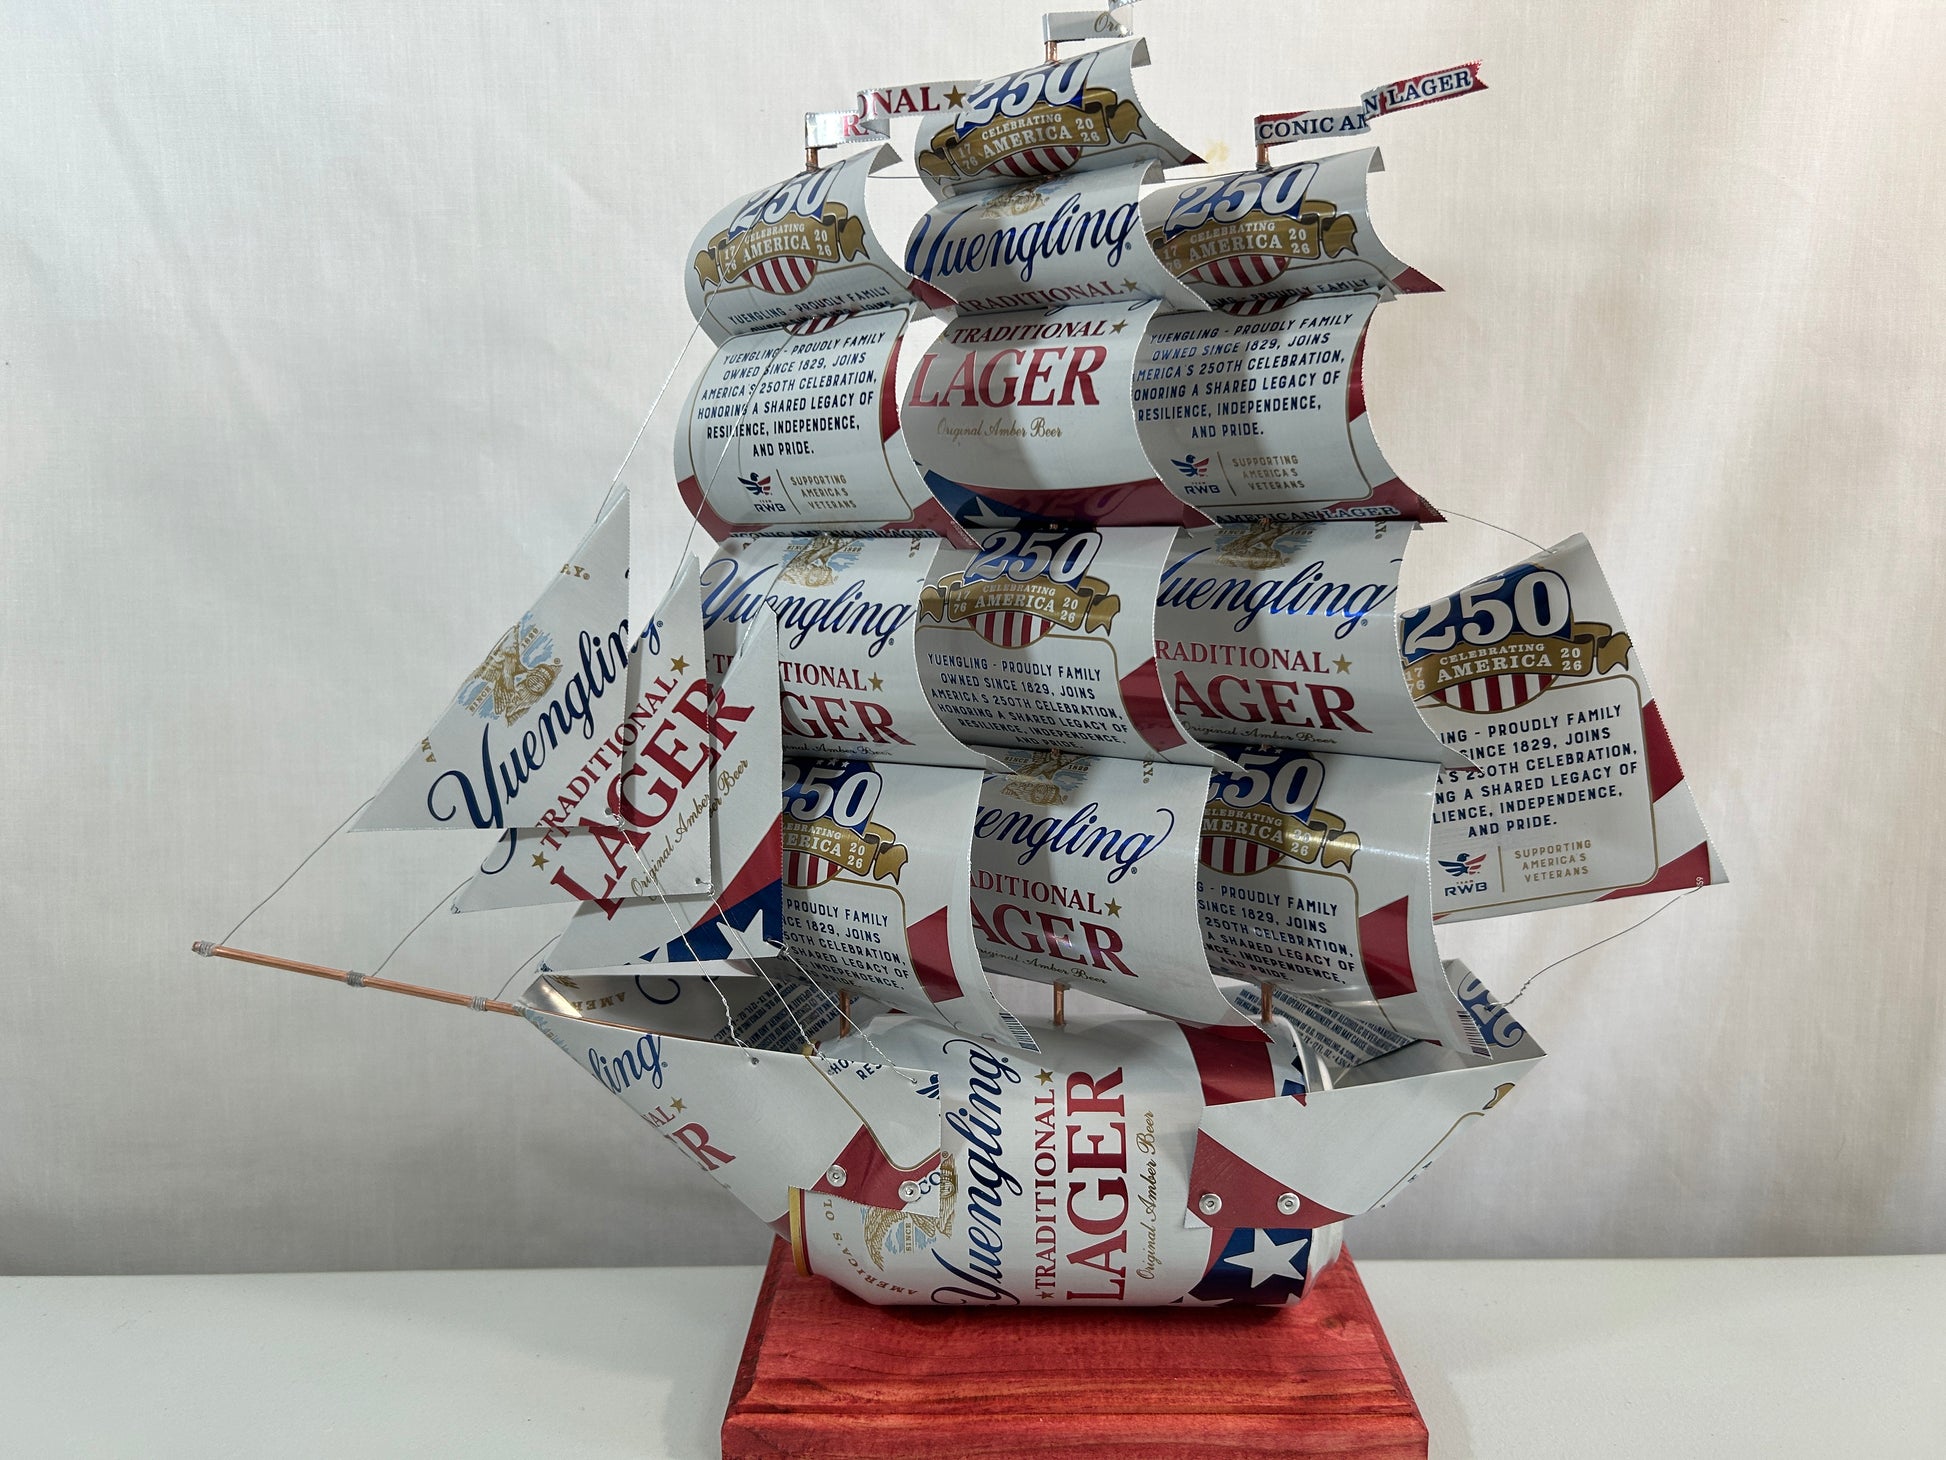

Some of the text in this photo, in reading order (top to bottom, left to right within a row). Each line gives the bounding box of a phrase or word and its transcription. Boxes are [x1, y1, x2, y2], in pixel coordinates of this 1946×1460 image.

[955, 53, 1099, 136] 250
[1387, 70, 1473, 107] LAGER
[981, 113, 1062, 141] CELEBRATING
[1256, 117, 1334, 139] CONIC
[982, 126, 1073, 160] AMERICA
[729, 161, 845, 236] 250
[1164, 163, 1319, 235] 250
[744, 223, 805, 244] CELEBRATING
[904, 192, 1139, 282] Yuengling
[1188, 234, 1283, 262] AMERICA
[1190, 222, 1276, 245] CELEBRATING
[742, 236, 811, 262] AMERICA
[956, 280, 1123, 312] TRADITIONAL
[951, 320, 1107, 344] TRADITIONAL
[1150, 314, 1353, 345] YUENGLING PROUDLY FAMILY
[723, 332, 887, 365] YUENGLING PROUDLY FAMILY
[1152, 332, 1330, 361] OWNED SINCE 1829, JOINS
[723, 352, 867, 381] OWNED SINCE 1829, JOINS
[908, 346, 1108, 408] LAGER
[1199, 350, 1345, 376] 250TH CELEBRATION,
[759, 370, 878, 395] 250TH CELEBRATION,
[1205, 370, 1341, 395] SHARED LEGACY OF
[697, 391, 874, 420] HONORING SHARED LEGACY OF
[1138, 395, 1321, 421] RESILIENCE, INDEPENDENCE,
[707, 414, 861, 440] RESILIENCE, INDEPENDENCE,
[984, 419, 1028, 437] Amber
[1030, 417, 1063, 437] Beer
[1192, 422, 1264, 439] AND PRIDE.
[753, 440, 815, 457] AND PRIDE.
[1232, 455, 1299, 467] SUPPORTING
[790, 474, 847, 486] SUPPORTING
[1248, 480, 1305, 491] VETERANS
[808, 500, 857, 510] VETERANS
[1323, 506, 1399, 518] LAGER
[965, 531, 1102, 585] 250
[974, 595, 1056, 613] AMERICA
[983, 585, 1056, 597] CELEBRATING
[1403, 569, 1571, 656] 250
[927, 653, 1101, 682] YUENGLING PROUDLY FAMILY
[1155, 640, 1330, 674] RADITIONAL
[1437, 654, 1552, 682] AMERICA
[1440, 643, 1545, 666] CELEBRATING
[1560, 648, 1580, 659] 20
[1562, 661, 1582, 671] 26
[941, 673, 1096, 700] OWNED SINCE 1829, JOINS
[994, 694, 1123, 720] 250TH CELEBRATION,
[1174, 670, 1373, 734] AGER
[937, 703, 1129, 734] HONORING SHARED LEGACY OF
[957, 718, 1126, 744] RESILIENCE, INDEPENDENCE,
[1488, 704, 1622, 738] PROUDLY FAMILY
[1460, 727, 1611, 761] SINCE 1829, JOINS
[1526, 742, 1637, 771] CELEBRATION,
[1464, 761, 1638, 801] A SHARED LEGACY OF
[550, 678, 756, 921] LAGER
[1500, 785, 1623, 814] INDEPENDENCE,
[630, 758, 749, 897] Original Beer
[1468, 814, 1557, 838] AND PRIDE.
[1514, 839, 1592, 860] SUPPORTING
[1444, 881, 1488, 897] RWB
[1524, 866, 1590, 883] VETERANS
[787, 898, 888, 928] PROUDLY FAMILY
[1221, 885, 1338, 918] PROUDLY FAMILY
[1199, 899, 1327, 934] SINCE 1829, JOINS
[806, 919, 881, 944] 1829, JOINS
[1205, 916, 1353, 957] 250TH CELEBRATION,
[793, 945, 909, 980] SHARED LEGACY OF
[819, 937, 906, 966] CELEBRATION,
[1220, 934, 1355, 972] SHARED LEGACY OF
[811, 959, 905, 990] INDEPENDENCE,
[1220, 957, 1294, 982] AND PRIDE.
[1239, 951, 1346, 985] INDEPENDENCE,
[930, 1039, 1024, 1305] Yuengling
[1066, 1067, 1129, 1301] LAGER
[1034, 1088, 1056, 1290] TRADITIONAL
[1136, 1110, 1163, 1280] Original Amber Beer
